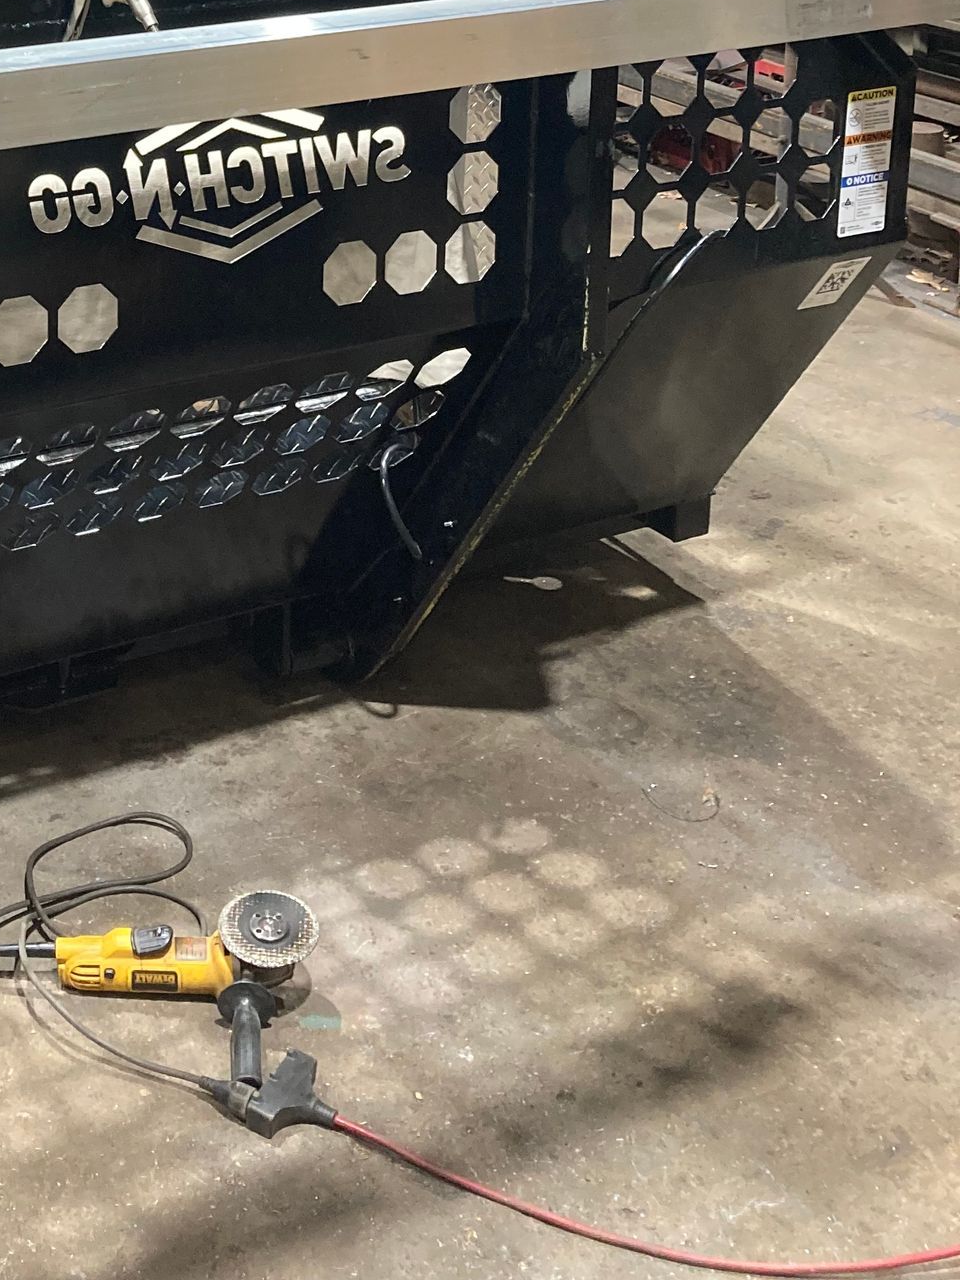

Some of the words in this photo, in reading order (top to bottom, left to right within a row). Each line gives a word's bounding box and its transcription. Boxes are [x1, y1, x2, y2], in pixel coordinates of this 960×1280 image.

[857, 89, 894, 101] CAUTION
[852, 130, 892, 143] WARNING
[853, 172, 884, 185] NOTICE
